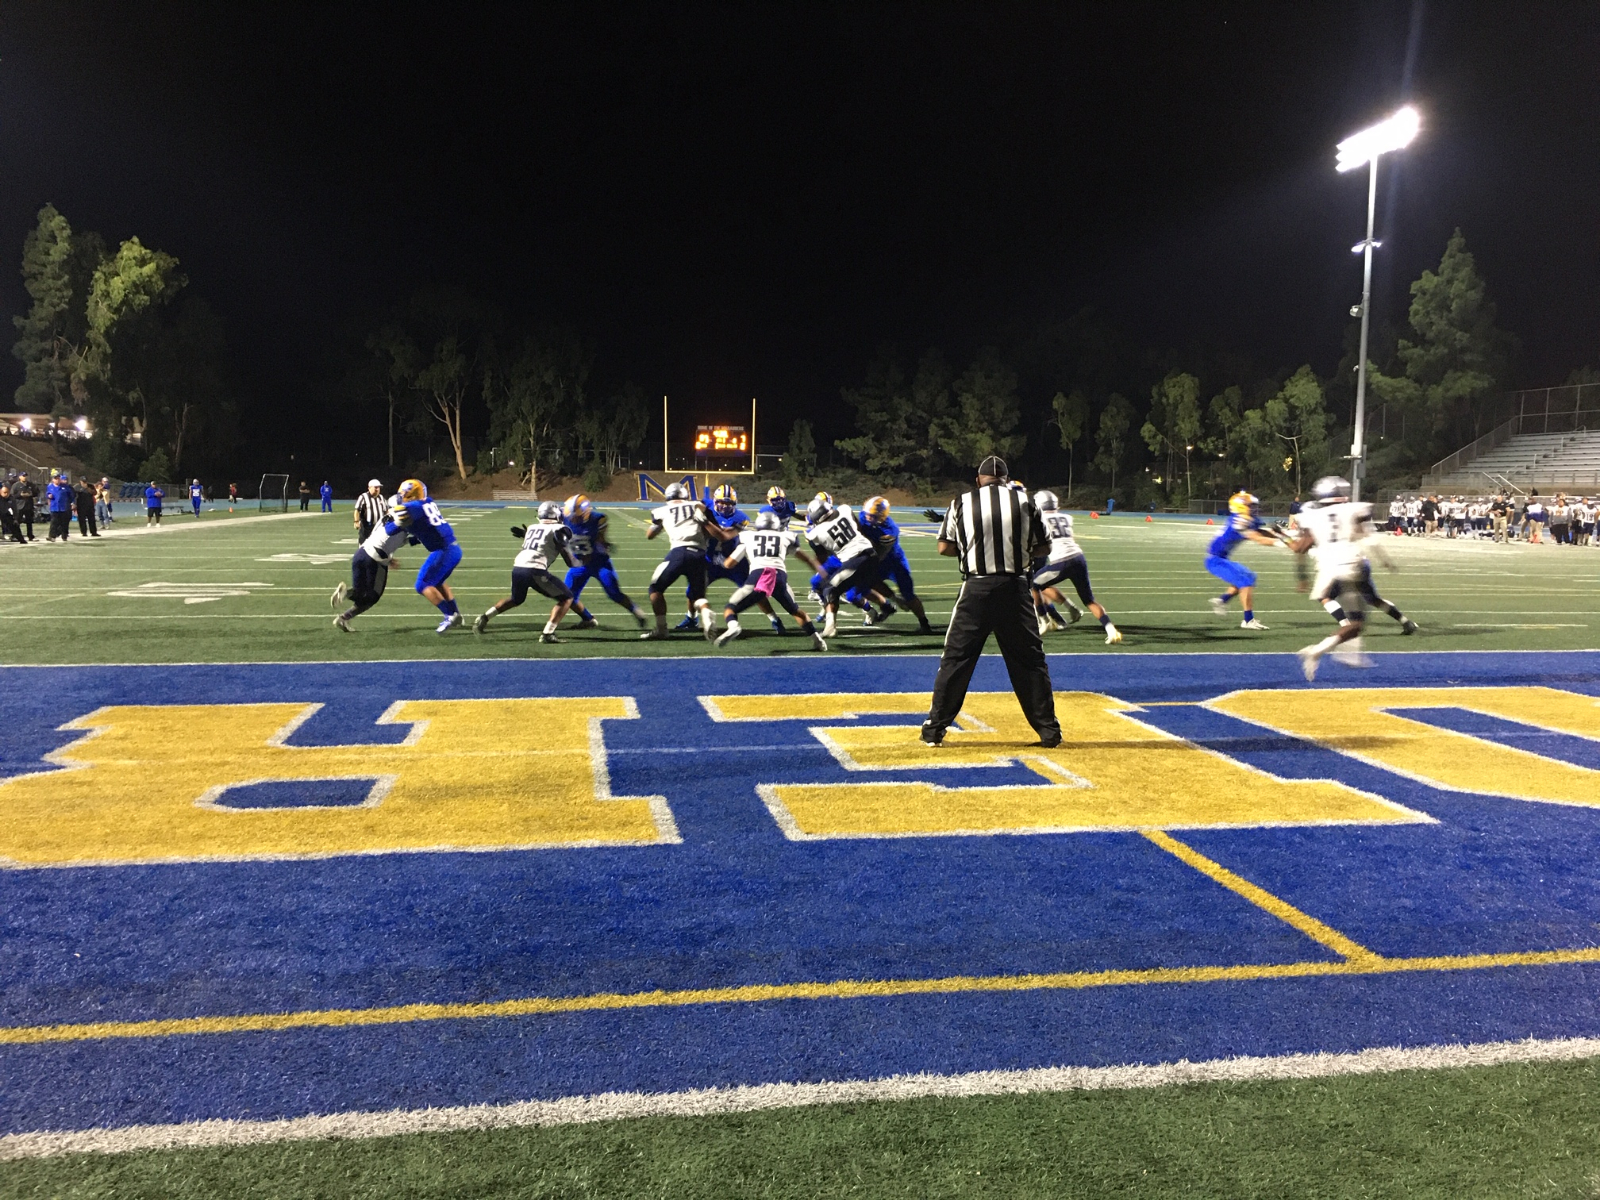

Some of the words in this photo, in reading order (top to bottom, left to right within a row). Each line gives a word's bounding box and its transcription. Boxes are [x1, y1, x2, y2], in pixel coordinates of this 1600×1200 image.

[634, 473, 700, 502] M
[669, 504, 694, 524] 70
[523, 529, 545, 551] 22
[827, 517, 857, 549] 58
[753, 535, 781, 558] 33
